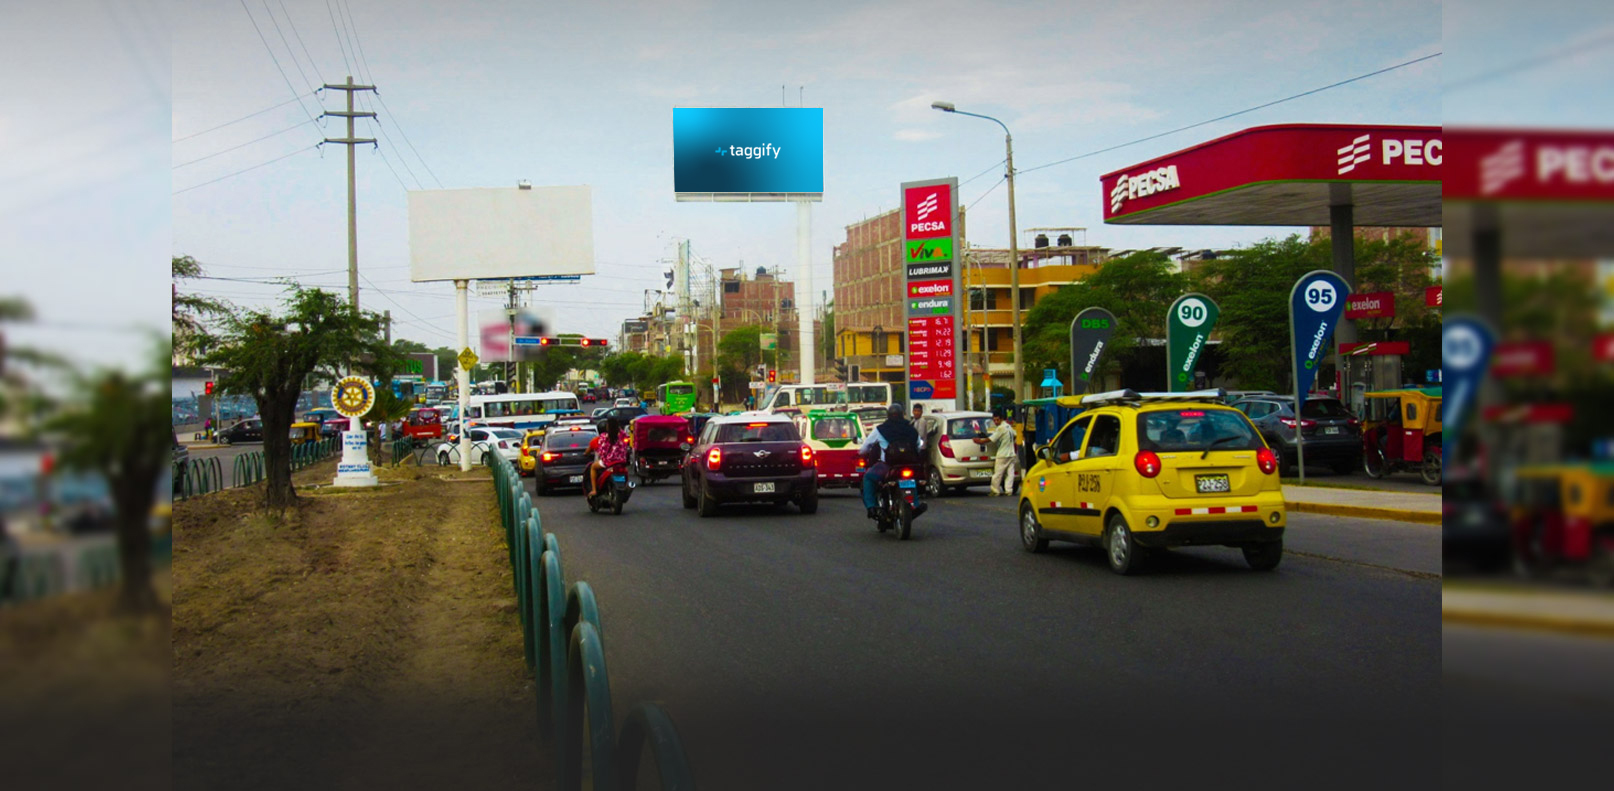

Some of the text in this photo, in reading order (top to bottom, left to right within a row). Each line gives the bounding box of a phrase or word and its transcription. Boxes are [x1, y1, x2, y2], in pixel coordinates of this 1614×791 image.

[730, 143, 781, 159] taggify
[1128, 165, 1181, 200] PECSA
[911, 221, 945, 232] PECSA
[909, 266, 949, 276] LUBRIMAX
[918, 284, 949, 294] exelon
[1308, 288, 1332, 304] 95
[918, 299, 948, 308] endura
[1351, 297, 1380, 311] exelon
[1181, 305, 1203, 320] 90
[1081, 318, 1110, 329] DB5
[1308, 321, 1328, 360] exelon
[1085, 340, 1104, 373] endura
[1183, 333, 1204, 372] exelon
